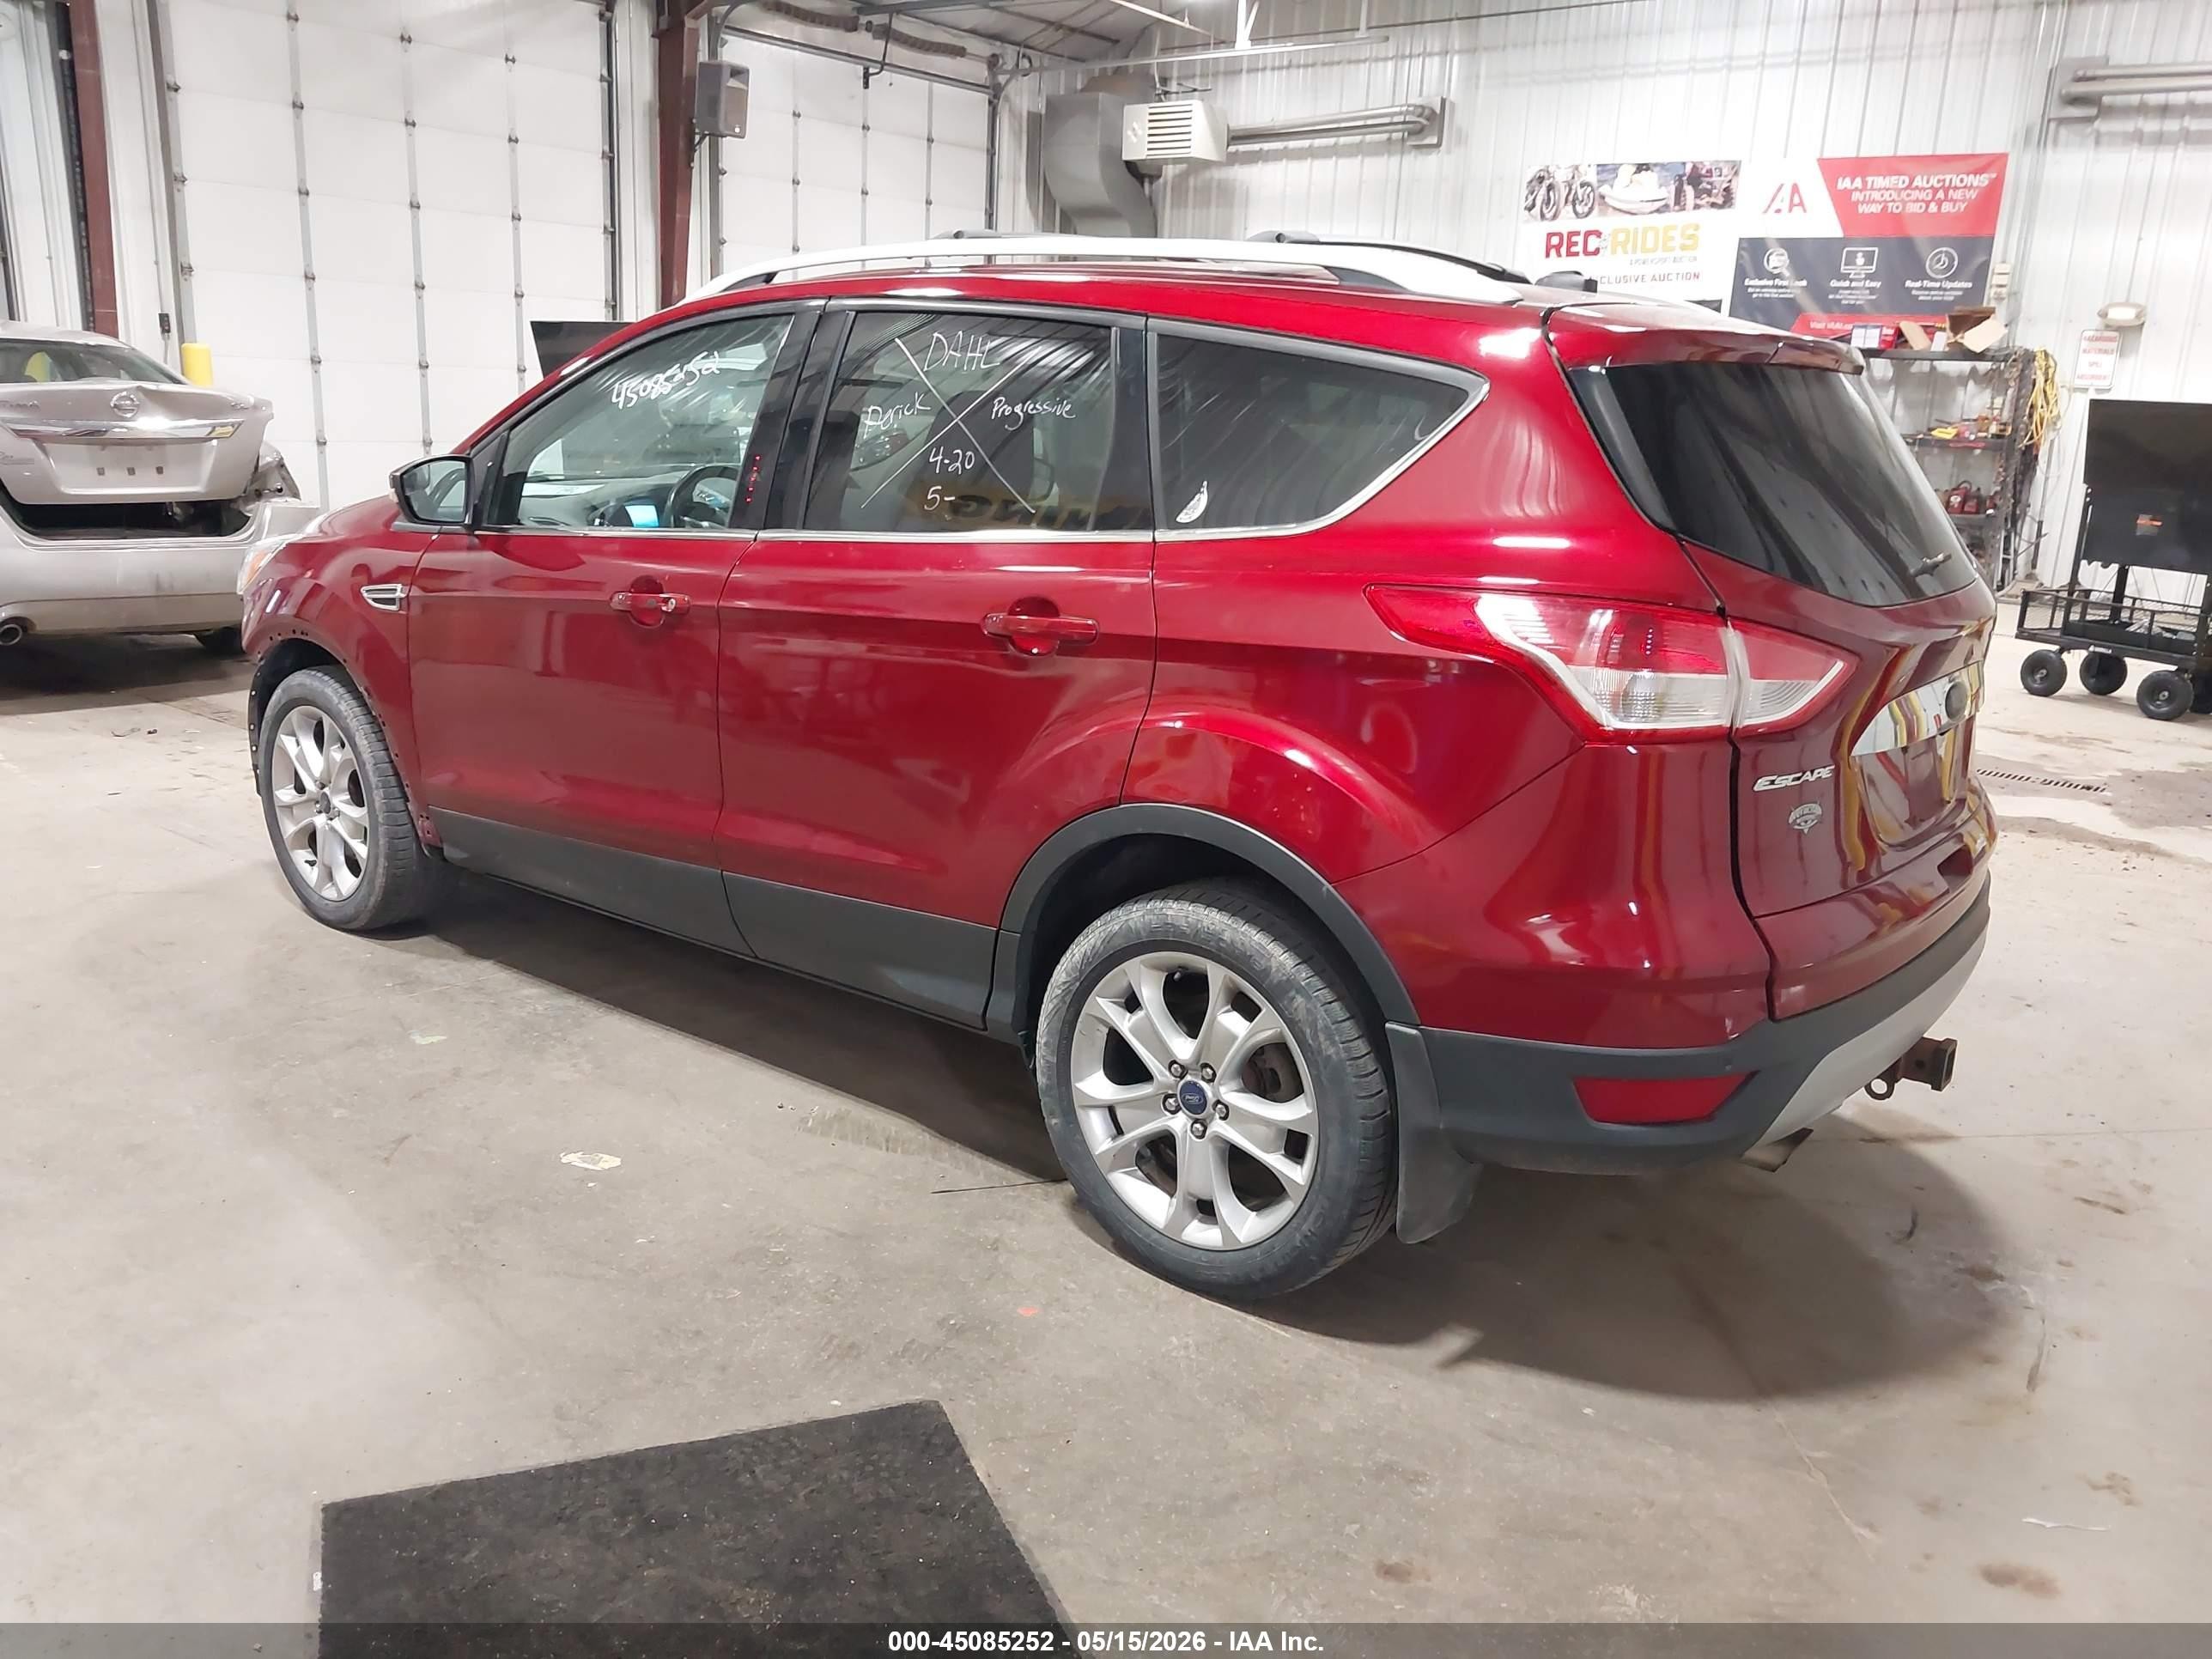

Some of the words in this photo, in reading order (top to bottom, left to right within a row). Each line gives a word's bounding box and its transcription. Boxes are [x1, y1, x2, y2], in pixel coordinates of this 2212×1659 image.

[1837, 176, 1863, 191] IAA
[1866, 174, 1910, 189] TIMED
[1851, 189, 1933, 202] INTRODUCING
[1935, 189, 1945, 200] A
[1948, 189, 1978, 200] NEW
[1857, 202, 1883, 214] WAY
[1887, 202, 1903, 213] TO
[1905, 201, 1925, 213] BID
[1928, 202, 1938, 213] &
[1941, 201, 1968, 213] BUY
[1545, 229, 1603, 258] REC
[1610, 223, 1701, 256] RIDES
[1597, 274, 1647, 285] CLUSIVE
[1650, 271, 1700, 283] AUCTION
[1942, 279, 1973, 289] Updates
[923, 331, 1000, 372] DAHL
[991, 397, 1076, 430] Progressive
[928, 447, 975, 474] 4-20
[923, 486, 956, 510] 5-
[1753, 764, 1835, 792] ESCAPE
